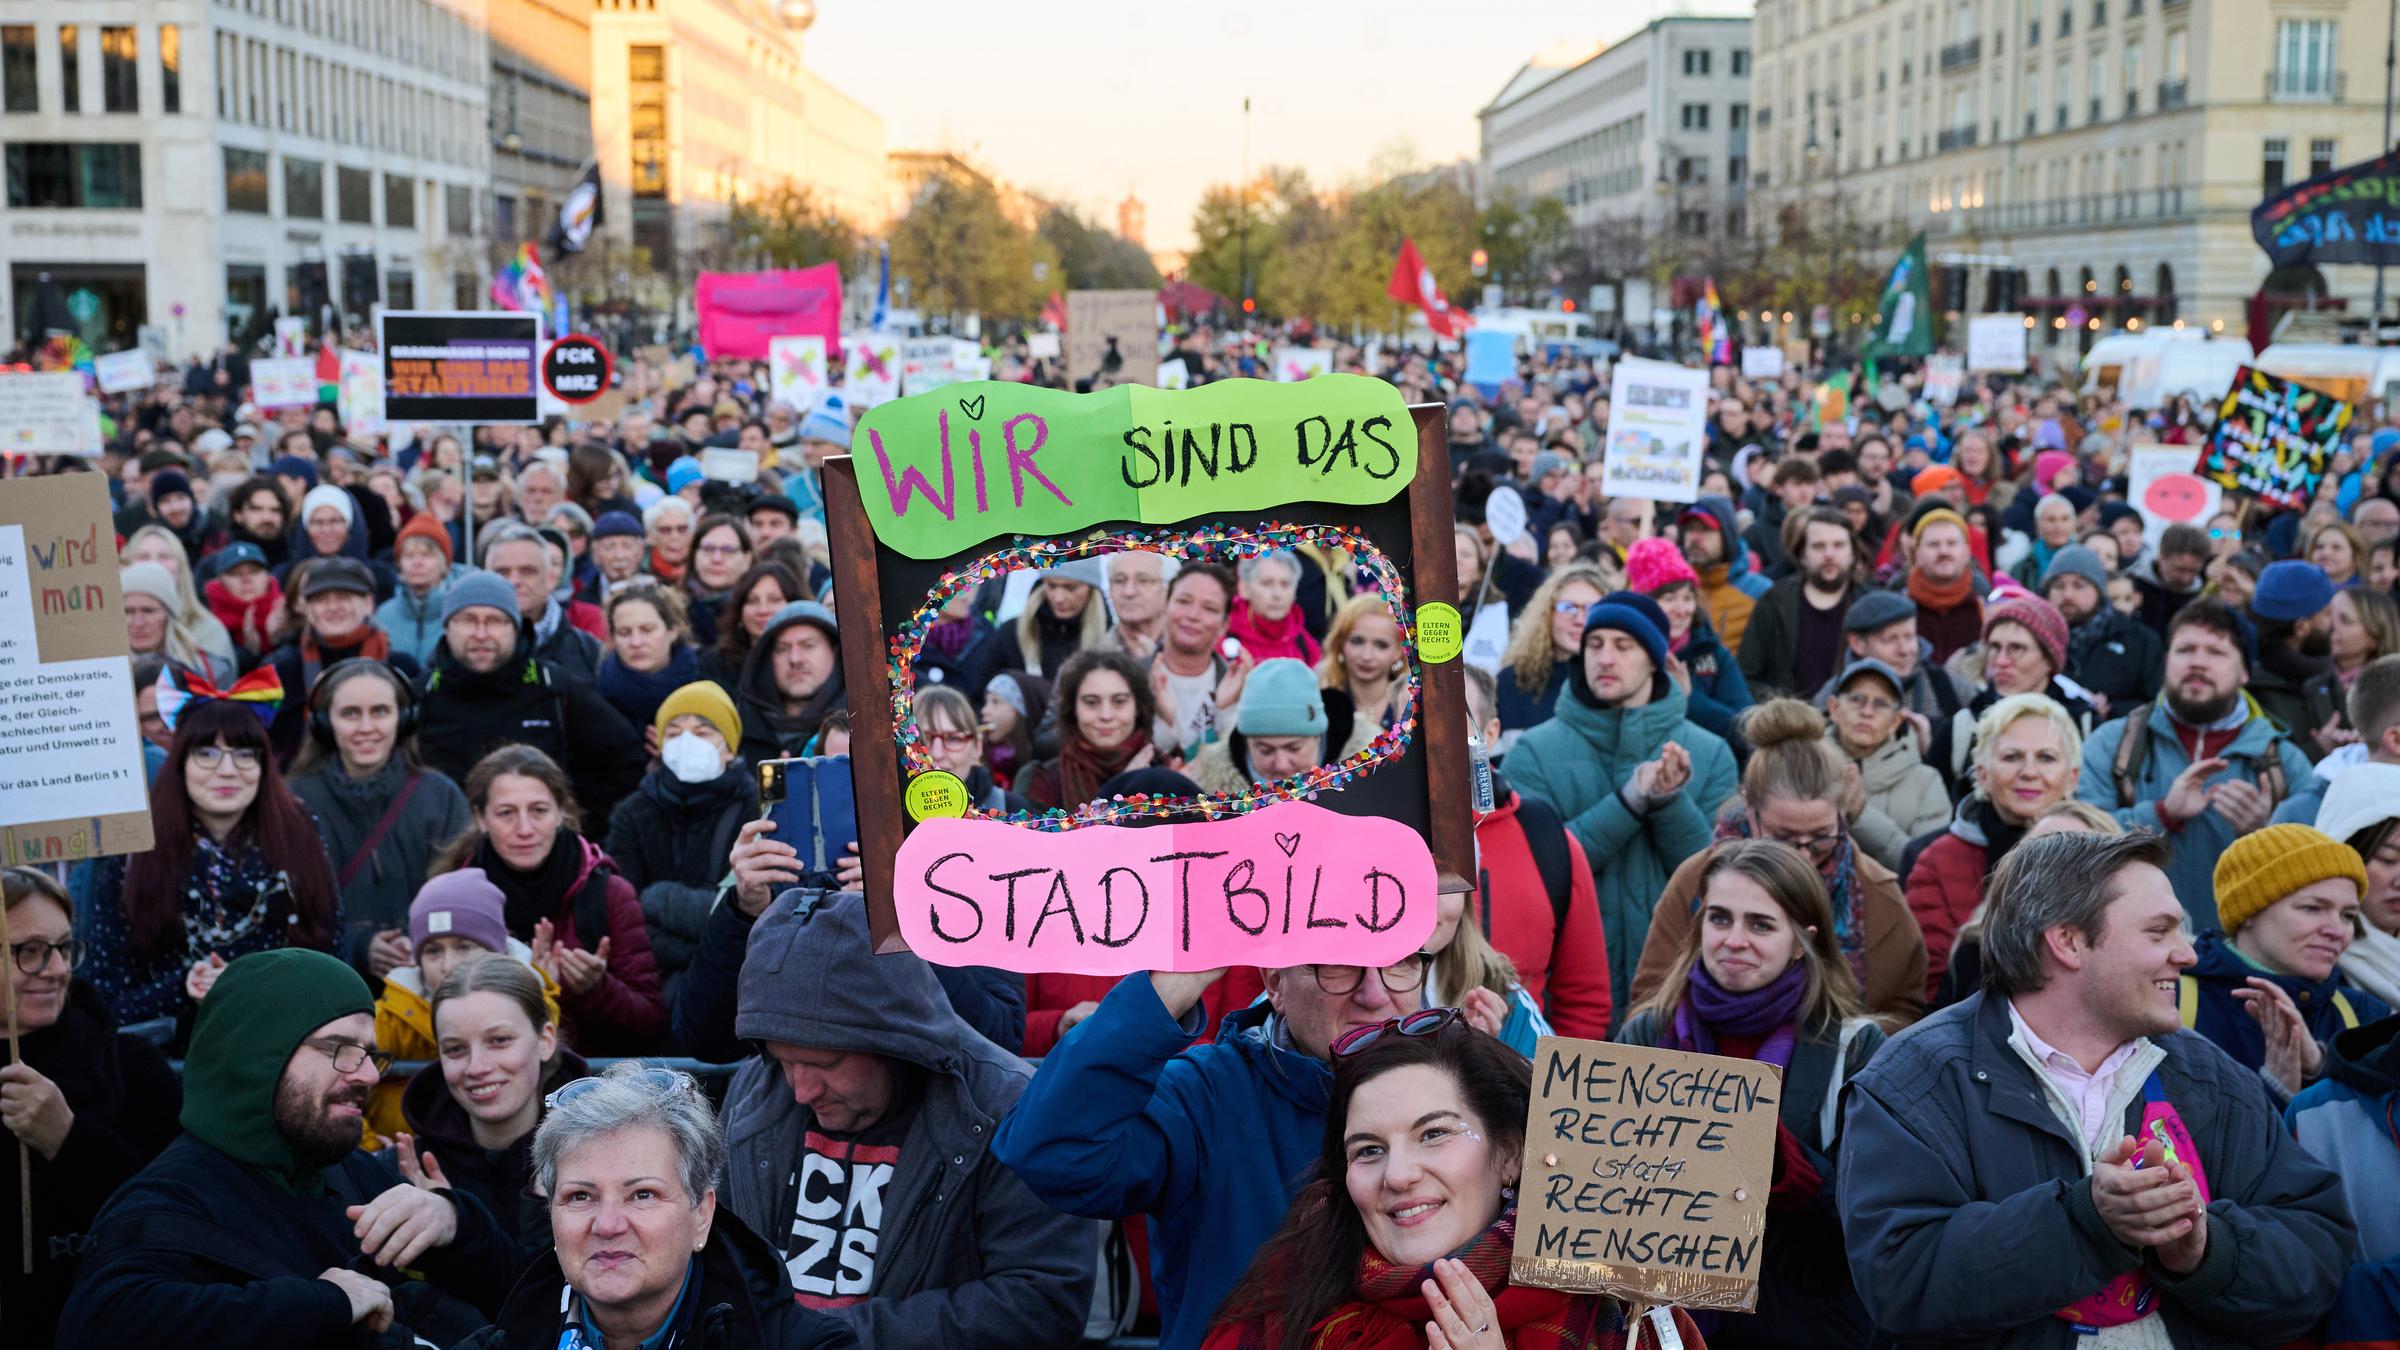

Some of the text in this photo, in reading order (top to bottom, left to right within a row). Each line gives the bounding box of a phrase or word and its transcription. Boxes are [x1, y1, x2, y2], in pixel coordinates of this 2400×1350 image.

[556, 347, 596, 363] FCK
[392, 360, 433, 375] WIR
[487, 360, 529, 375] DAS
[393, 375, 529, 393] STADTBILD
[556, 375, 598, 391] MRZ
[1296, 414, 1401, 480] DAS
[32, 523, 97, 570] wird
[42, 584, 104, 615] man
[14, 677, 34, 687] der
[37, 671, 113, 685] Demokratie,
[12, 690, 63, 704] Freiheit,
[65, 689, 86, 699] der
[15, 711, 34, 720] der
[37, 705, 83, 718] Gleich-
[69, 721, 92, 732] und
[95, 720, 111, 729] im
[26, 742, 49, 753] und
[52, 736, 100, 750] Umwelt
[103, 735, 117, 745] zu
[17, 779, 39, 789] das
[41, 774, 72, 786] Land
[74, 770, 110, 783] Berlin
[921, 788, 949, 797] ELTERN
[924, 795, 949, 804] GEGEN
[923, 801, 952, 810] RECHTS
[1542, 1050, 1776, 1114] MENSCHEN-
[1550, 1107, 1734, 1151] RECHTE
[788, 1153, 895, 1231] CK
[1545, 1173, 1720, 1222] RECHTE
[778, 1218, 880, 1296] ZS
[1535, 1223, 1759, 1274] MENSCHEN
